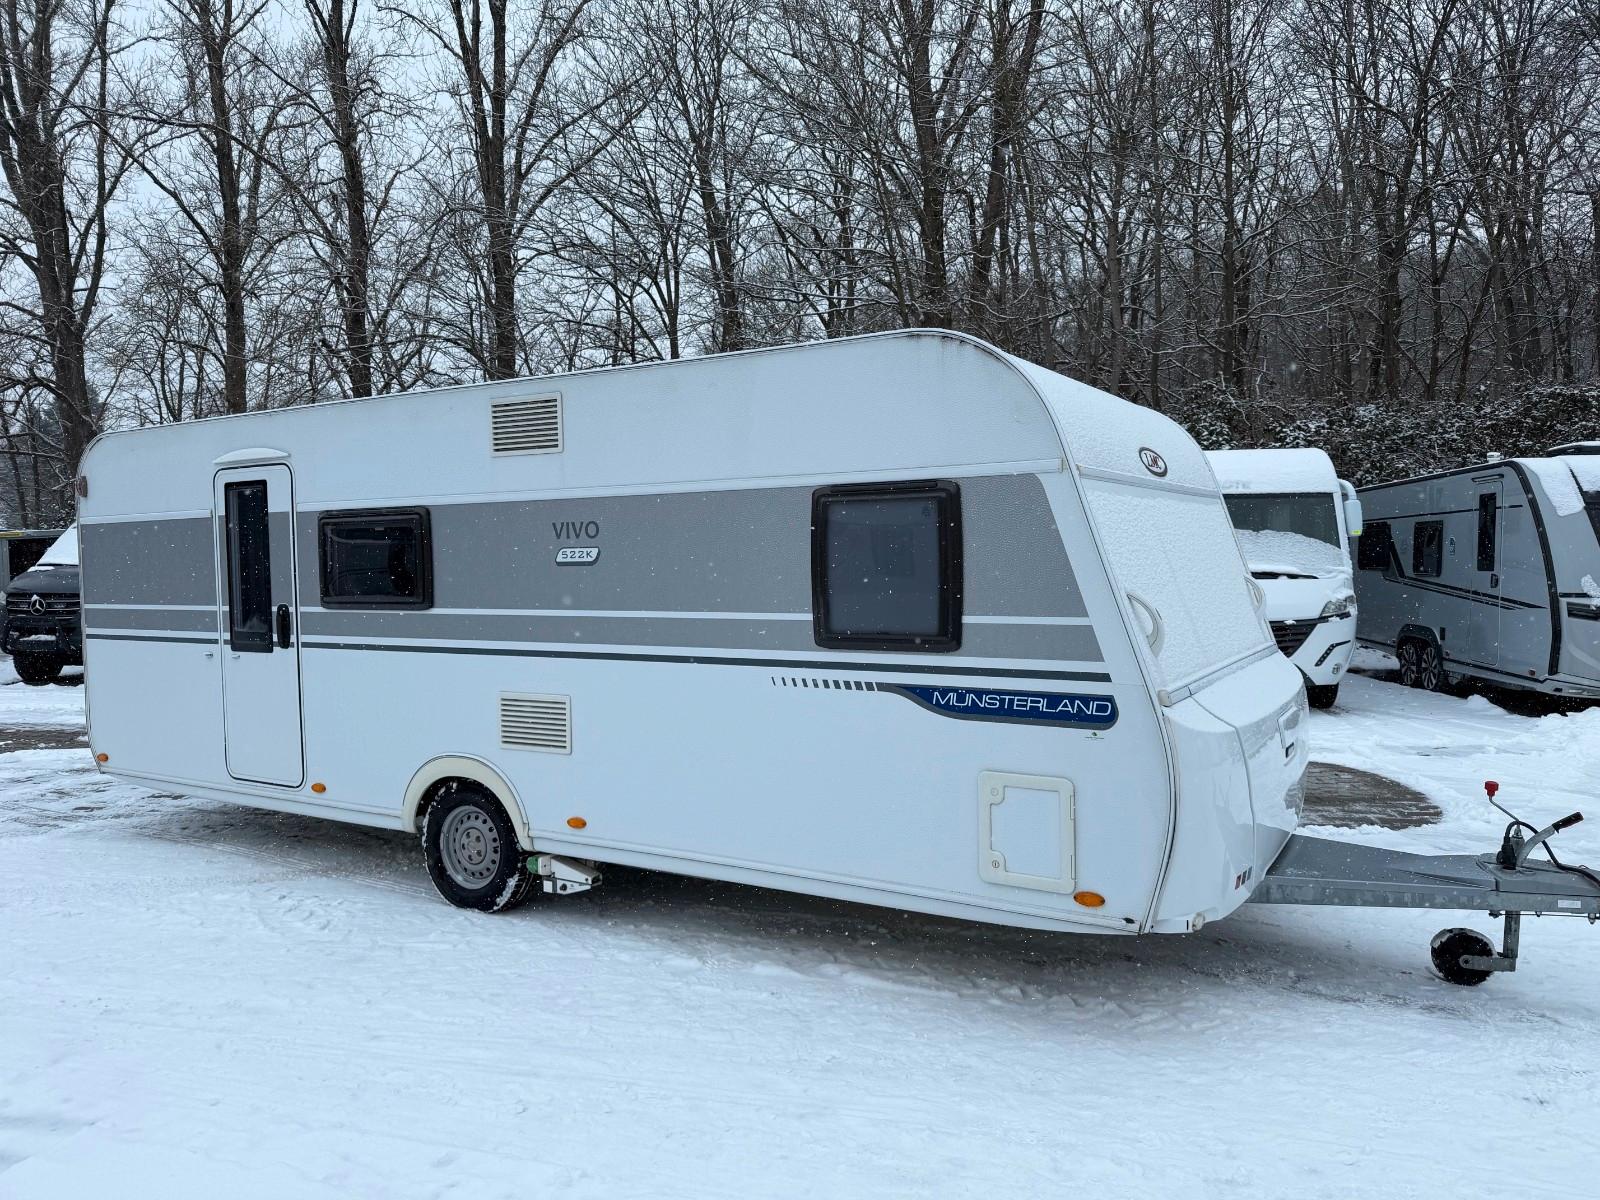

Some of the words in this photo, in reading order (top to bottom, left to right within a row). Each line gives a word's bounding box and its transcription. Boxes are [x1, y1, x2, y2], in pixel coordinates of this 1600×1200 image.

[552, 521, 600, 539] VIVO
[561, 550, 594, 559] 522K
[932, 689, 1112, 716] MÜNSTERLAND
